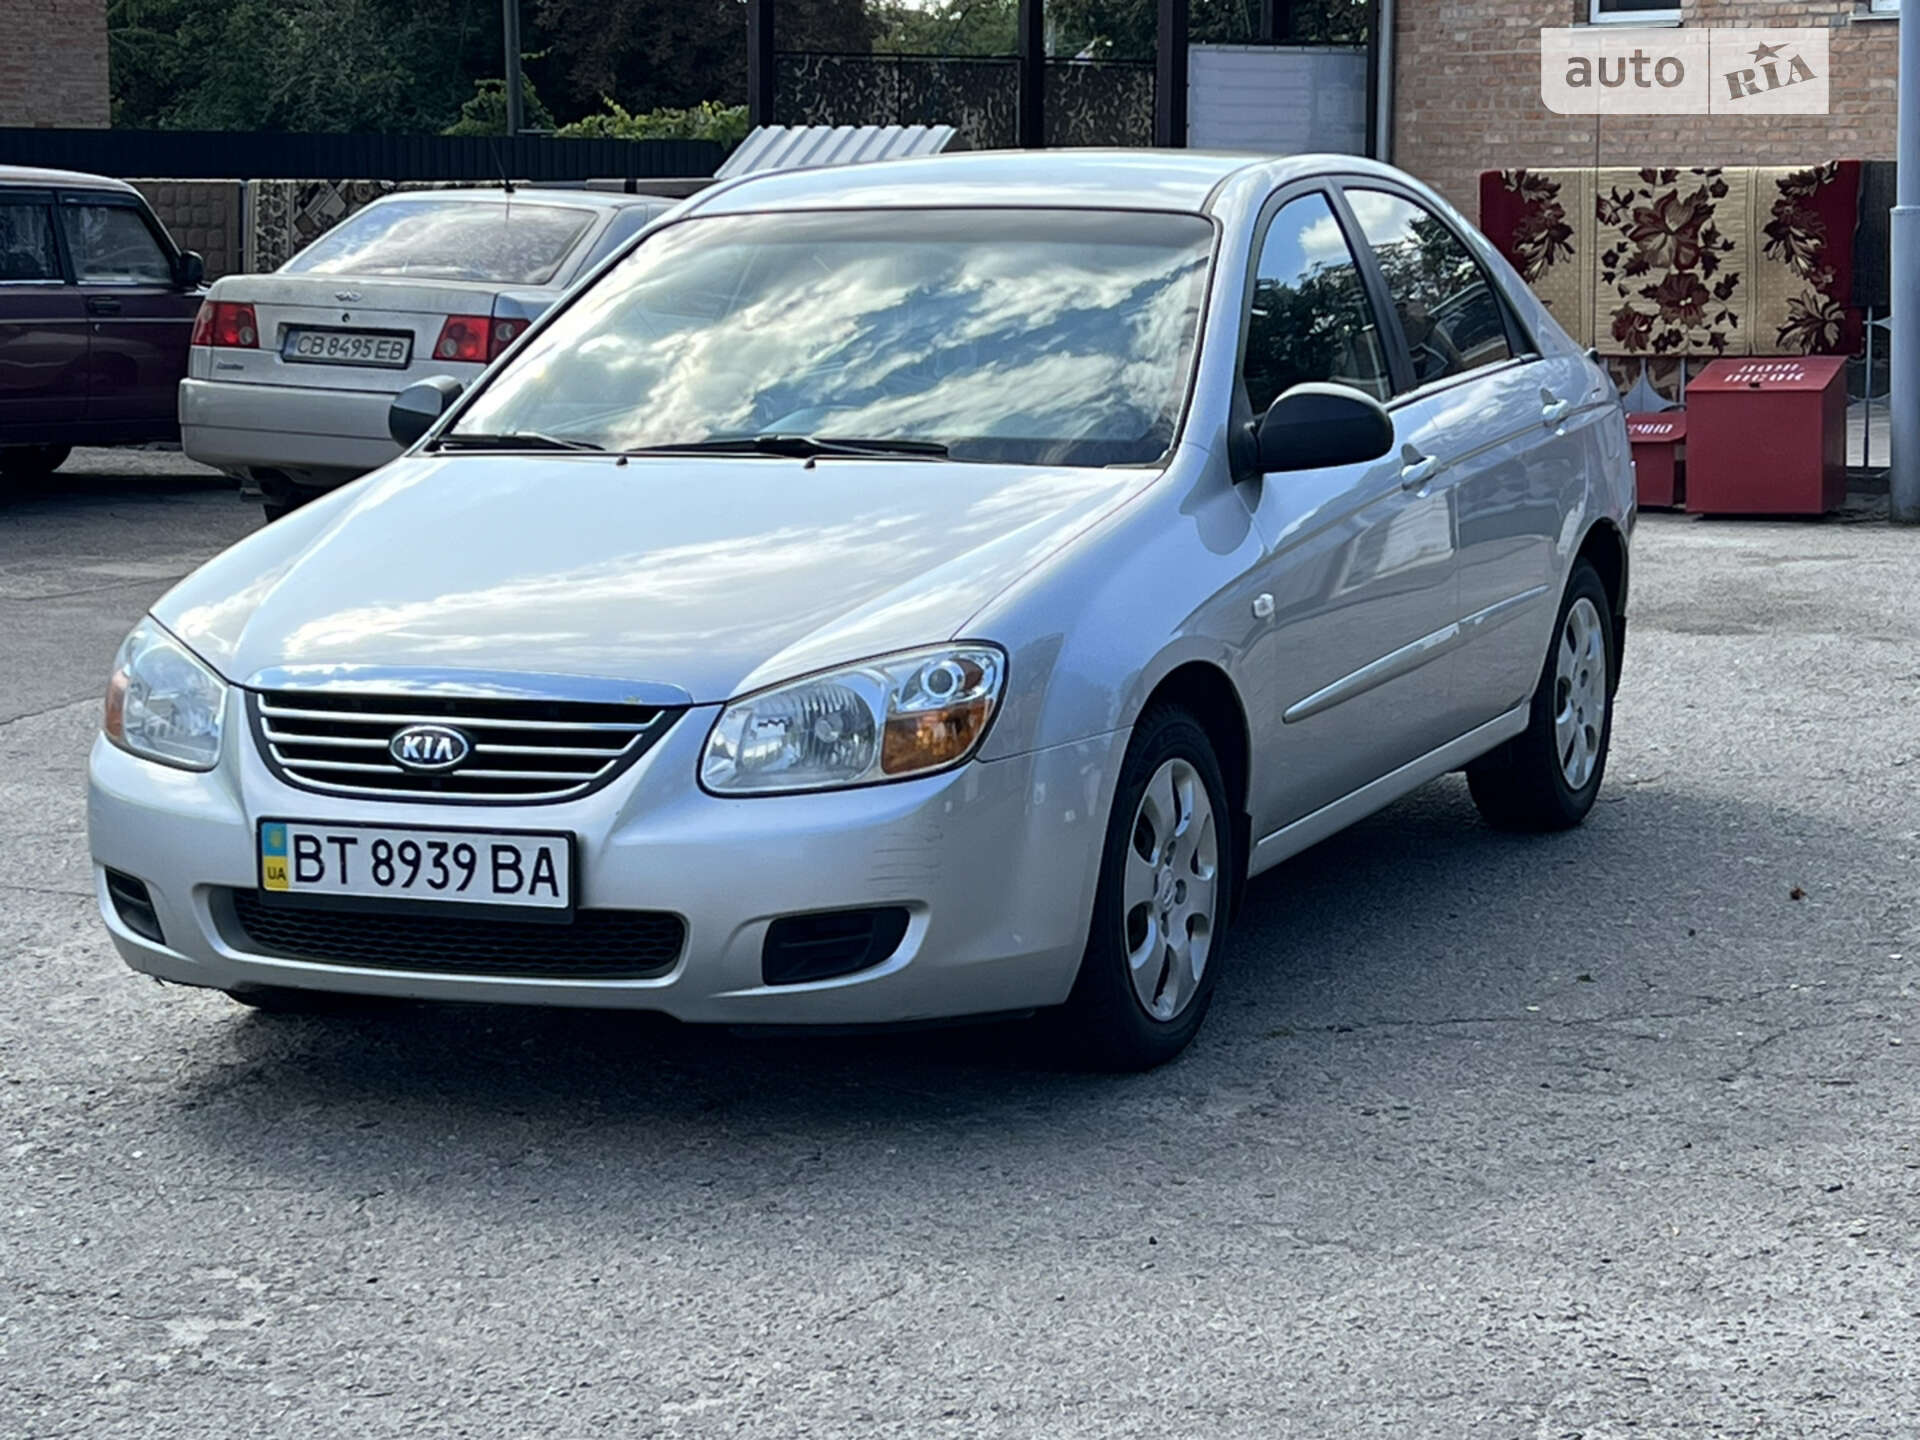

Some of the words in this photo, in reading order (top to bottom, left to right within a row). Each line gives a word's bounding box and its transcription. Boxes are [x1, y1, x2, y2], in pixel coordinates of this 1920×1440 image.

[297, 335, 325, 355] CB
[327, 337, 374, 358] 8495
[374, 340, 404, 360] EB
[402, 735, 453, 760] KIA
[266, 866, 287, 882] UA
[293, 833, 358, 885] BT
[371, 838, 477, 892] 8939
[490, 844, 560, 898] BA
